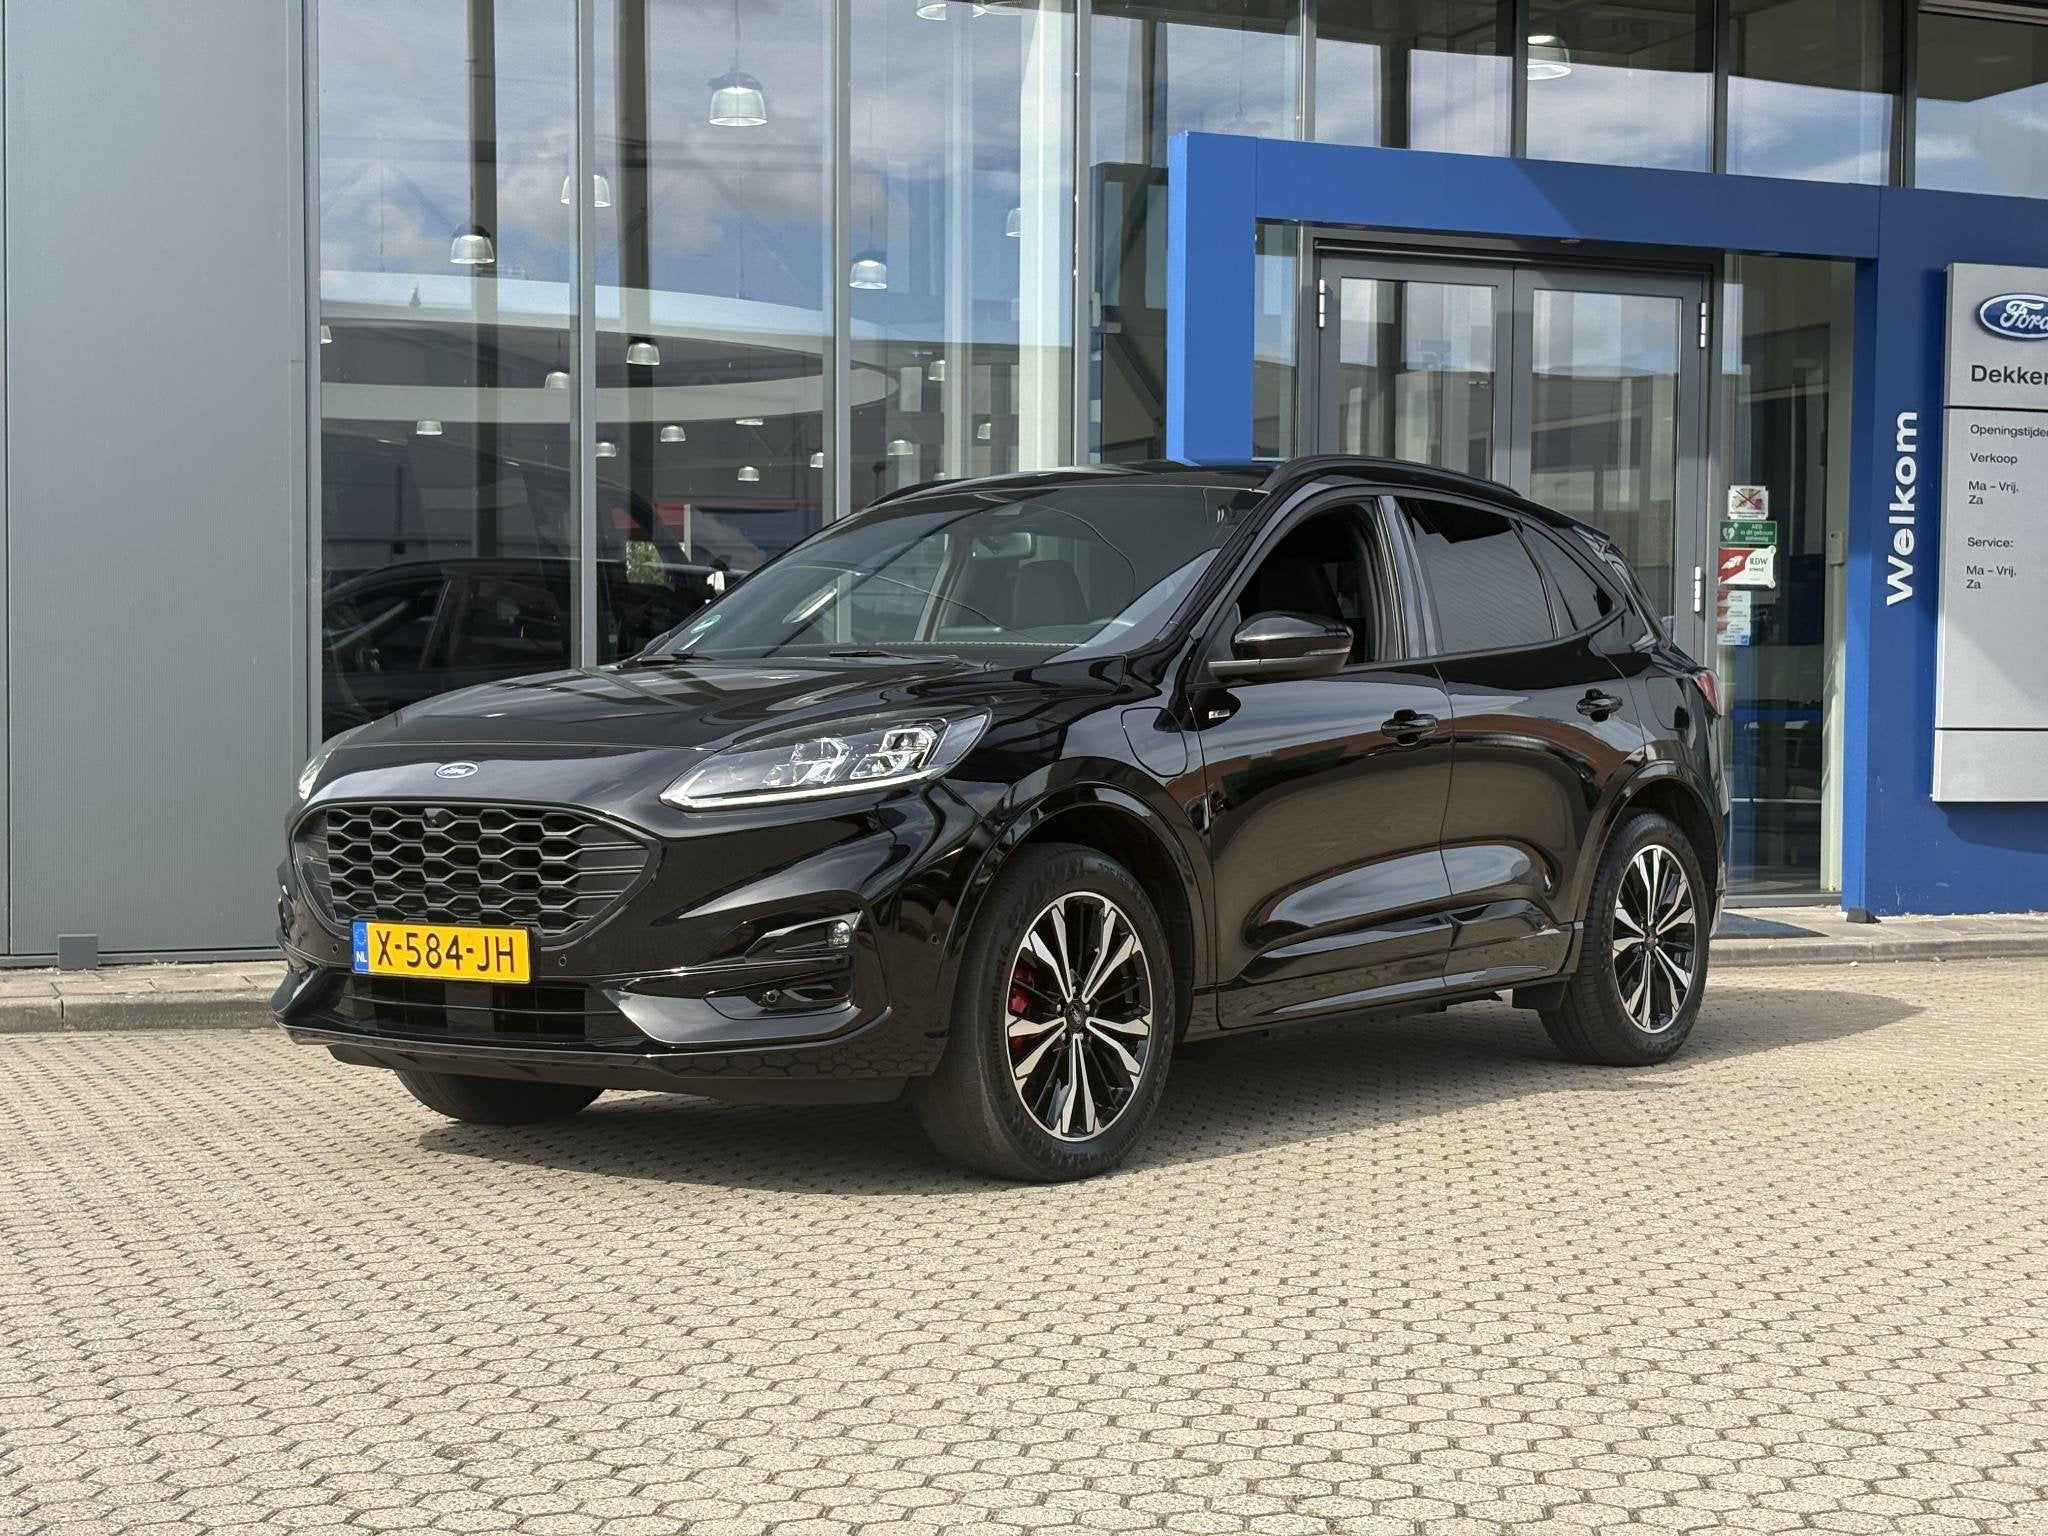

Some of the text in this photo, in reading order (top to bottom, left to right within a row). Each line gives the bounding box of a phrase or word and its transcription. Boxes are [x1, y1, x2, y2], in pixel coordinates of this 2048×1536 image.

[1970, 452, 2018, 465] Verkoop
[1968, 480, 1986, 492] Ma
[1998, 481, 2019, 494] Vrij.
[1968, 494, 1984, 506] Za
[1886, 411, 1918, 606] Welkom
[1967, 536, 2014, 548] Service:
[1749, 557, 1769, 566] RDW
[1966, 565, 1984, 576] Ma
[1996, 565, 2017, 578] Vrij.
[1966, 578, 1982, 590] Za
[356, 930, 515, 973] NL X-584-JH
